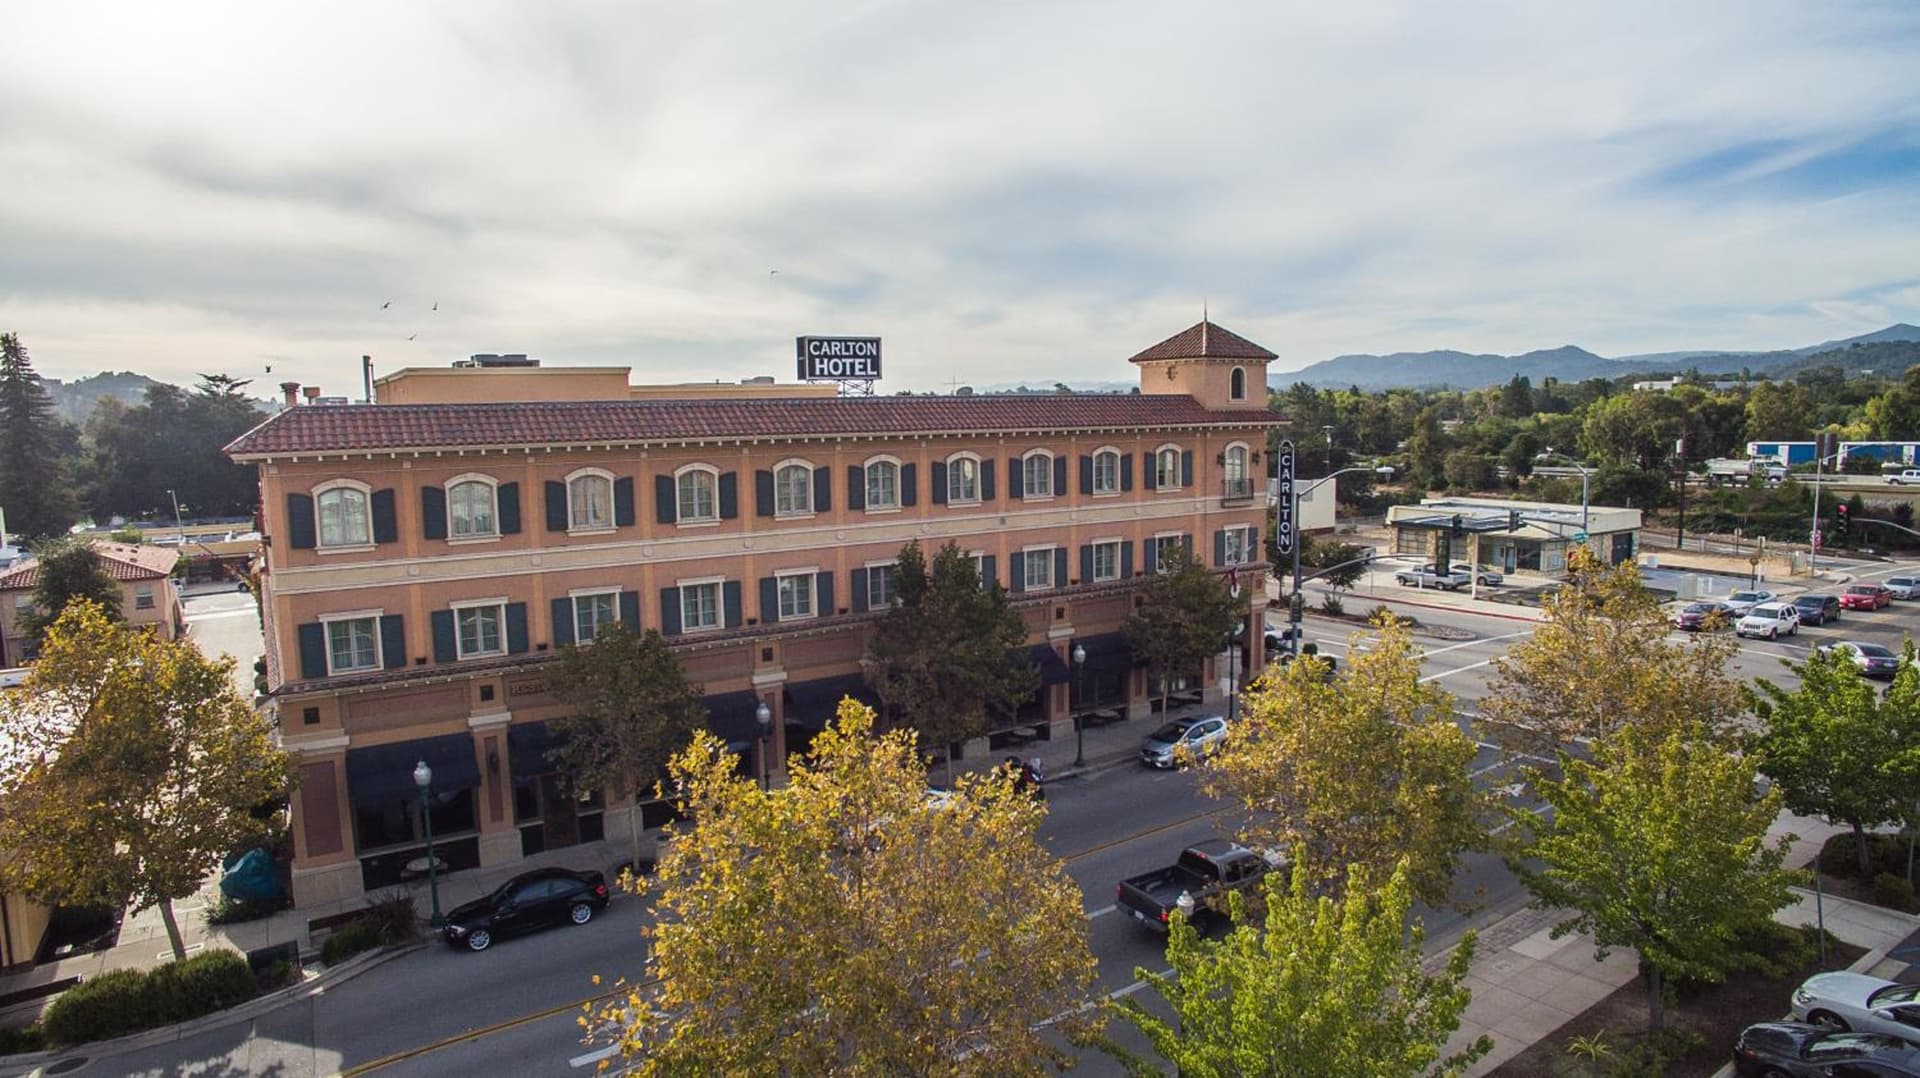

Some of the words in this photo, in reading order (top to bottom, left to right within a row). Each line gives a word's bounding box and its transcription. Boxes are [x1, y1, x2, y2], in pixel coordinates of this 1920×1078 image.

[810, 342, 877, 355] CARLTON
[815, 358, 877, 375] HOTEL
[1280, 455, 1291, 544] CARLTON
